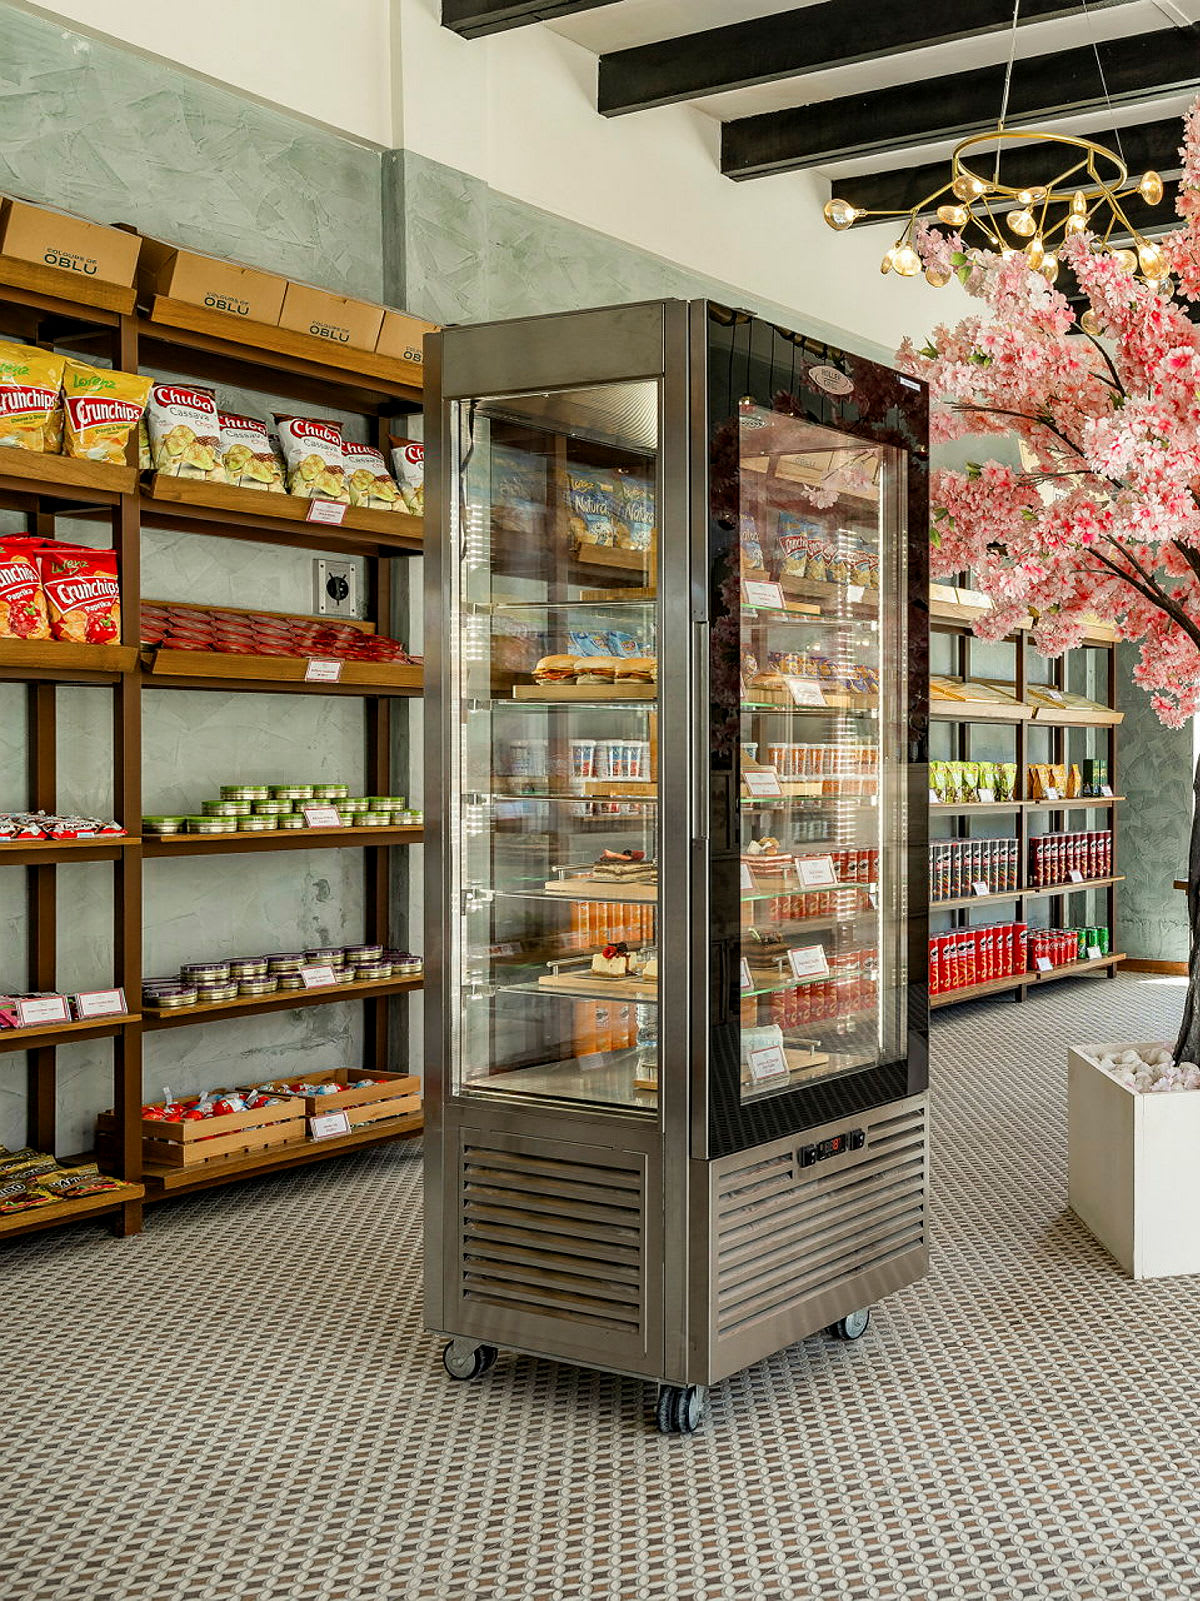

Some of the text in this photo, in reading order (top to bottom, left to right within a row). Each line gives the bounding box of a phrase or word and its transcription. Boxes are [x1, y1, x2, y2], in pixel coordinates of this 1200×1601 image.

[44, 253, 97, 275] OBLU
[204, 297, 249, 315] OBLU
[310, 325, 350, 342] OBLU
[0, 389, 55, 411] runchips
[157, 388, 212, 413] Chuba
[76, 400, 140, 424] Crunchips
[170, 407, 210, 421] Cassava
[293, 420, 340, 445] Chuba
[6, 588, 34, 602] Paprika
[57, 579, 119, 604] Crunchips
[84, 601, 112, 613] Paprika
